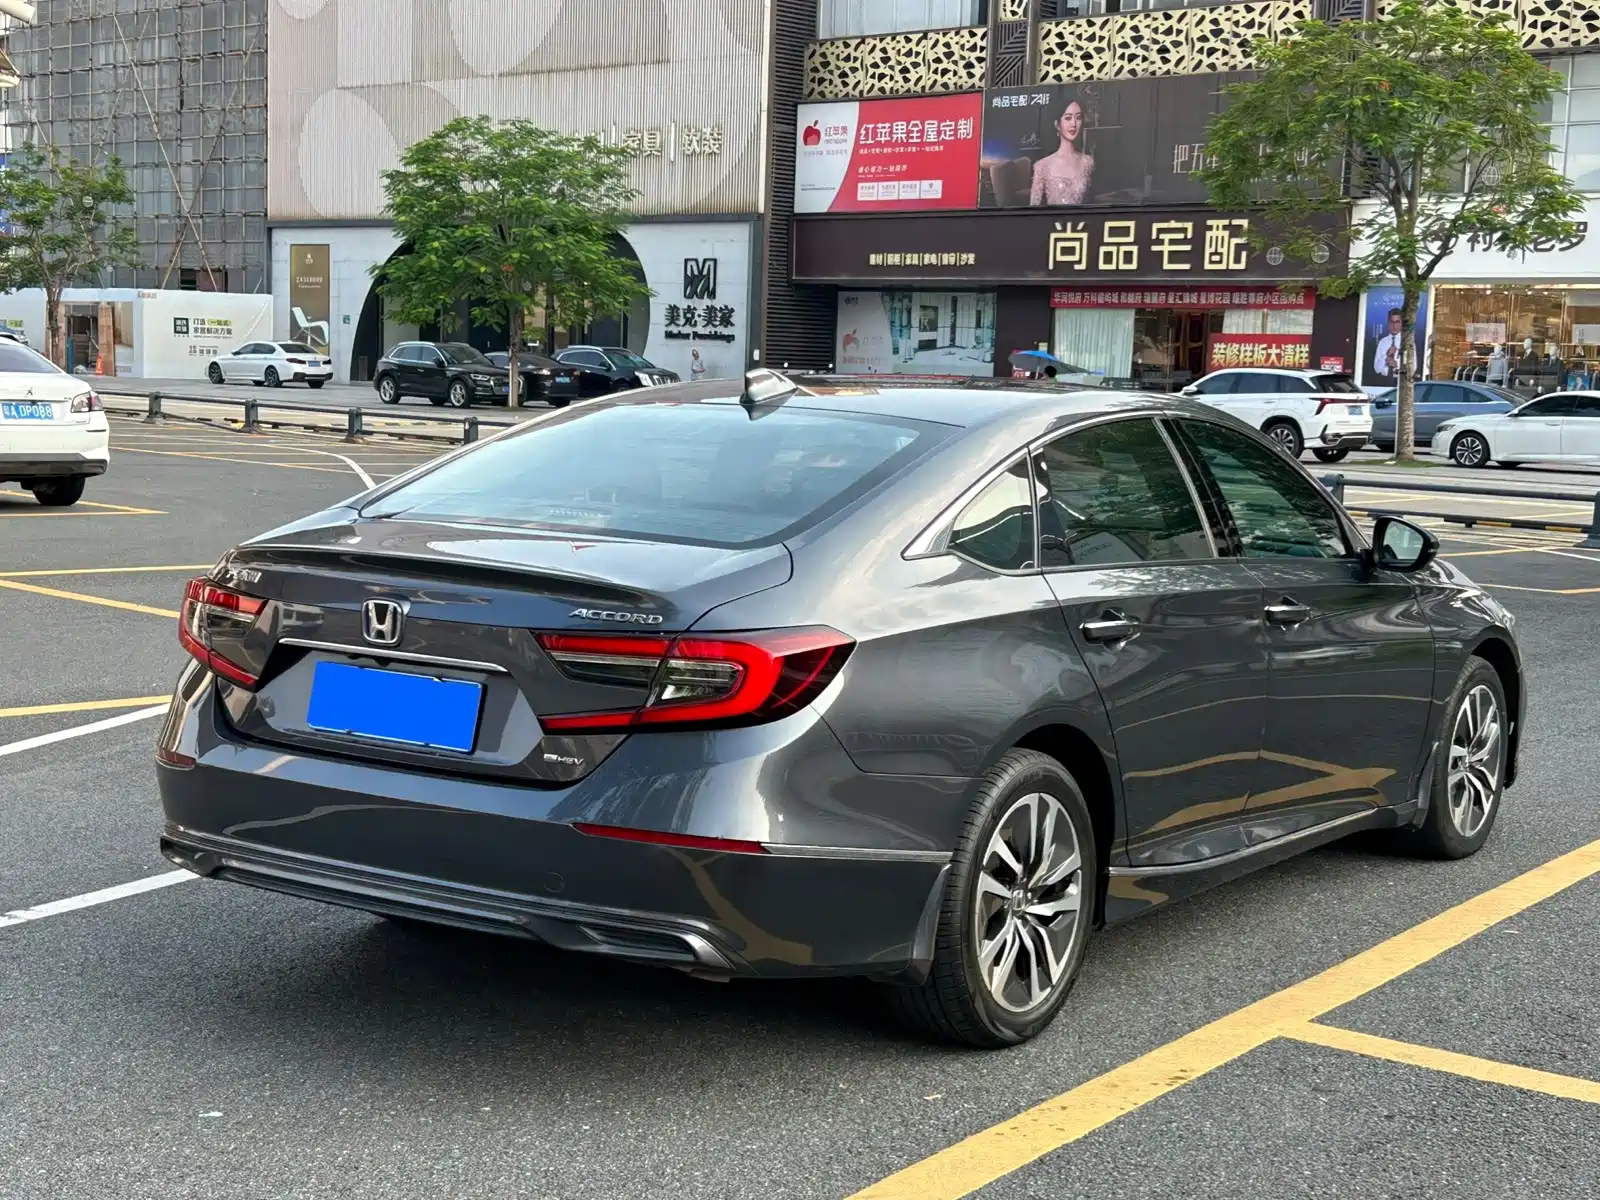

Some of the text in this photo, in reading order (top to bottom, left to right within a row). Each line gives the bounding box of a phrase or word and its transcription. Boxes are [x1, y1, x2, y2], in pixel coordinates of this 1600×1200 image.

[682, 127, 722, 155] 软装
[859, 117, 973, 145] 红苹果全屋定制
[1048, 219, 1249, 271] 尚品宅配
[568, 608, 663, 625] ACCORD
